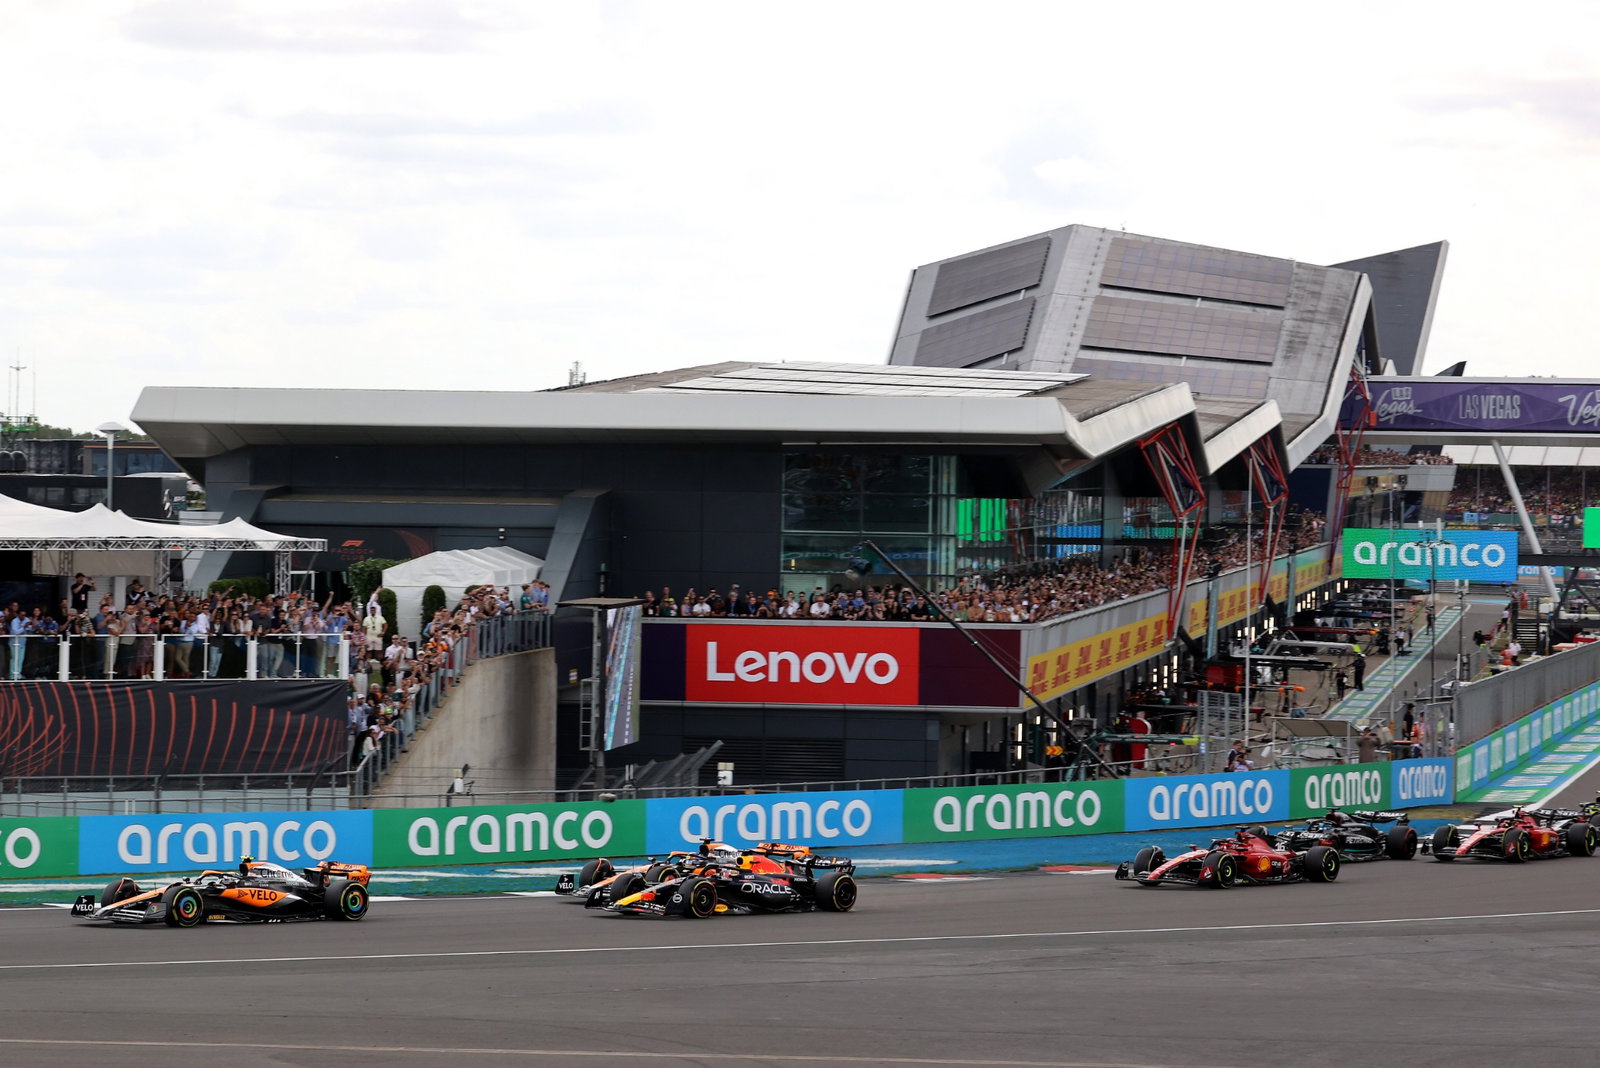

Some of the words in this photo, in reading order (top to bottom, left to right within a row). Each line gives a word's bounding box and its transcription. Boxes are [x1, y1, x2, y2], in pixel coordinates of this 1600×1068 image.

[1459, 395, 1479, 419] LAS
[1481, 394, 1521, 419] VEGAS
[1353, 541, 1506, 567] aramco
[706, 641, 899, 685] Lenovo
[1149, 779, 1273, 820] aramco
[1305, 770, 1381, 809] aramco
[1399, 765, 1446, 800] aramco
[679, 799, 872, 844] aramco
[933, 789, 1101, 833] aramco
[0, 827, 41, 869] o
[118, 820, 336, 864] aramco
[408, 810, 613, 856] aramco
[249, 889, 278, 901] VELO
[559, 882, 574, 890] VELO
[741, 882, 792, 894] ORACLE
[76, 904, 94, 912] VELO
